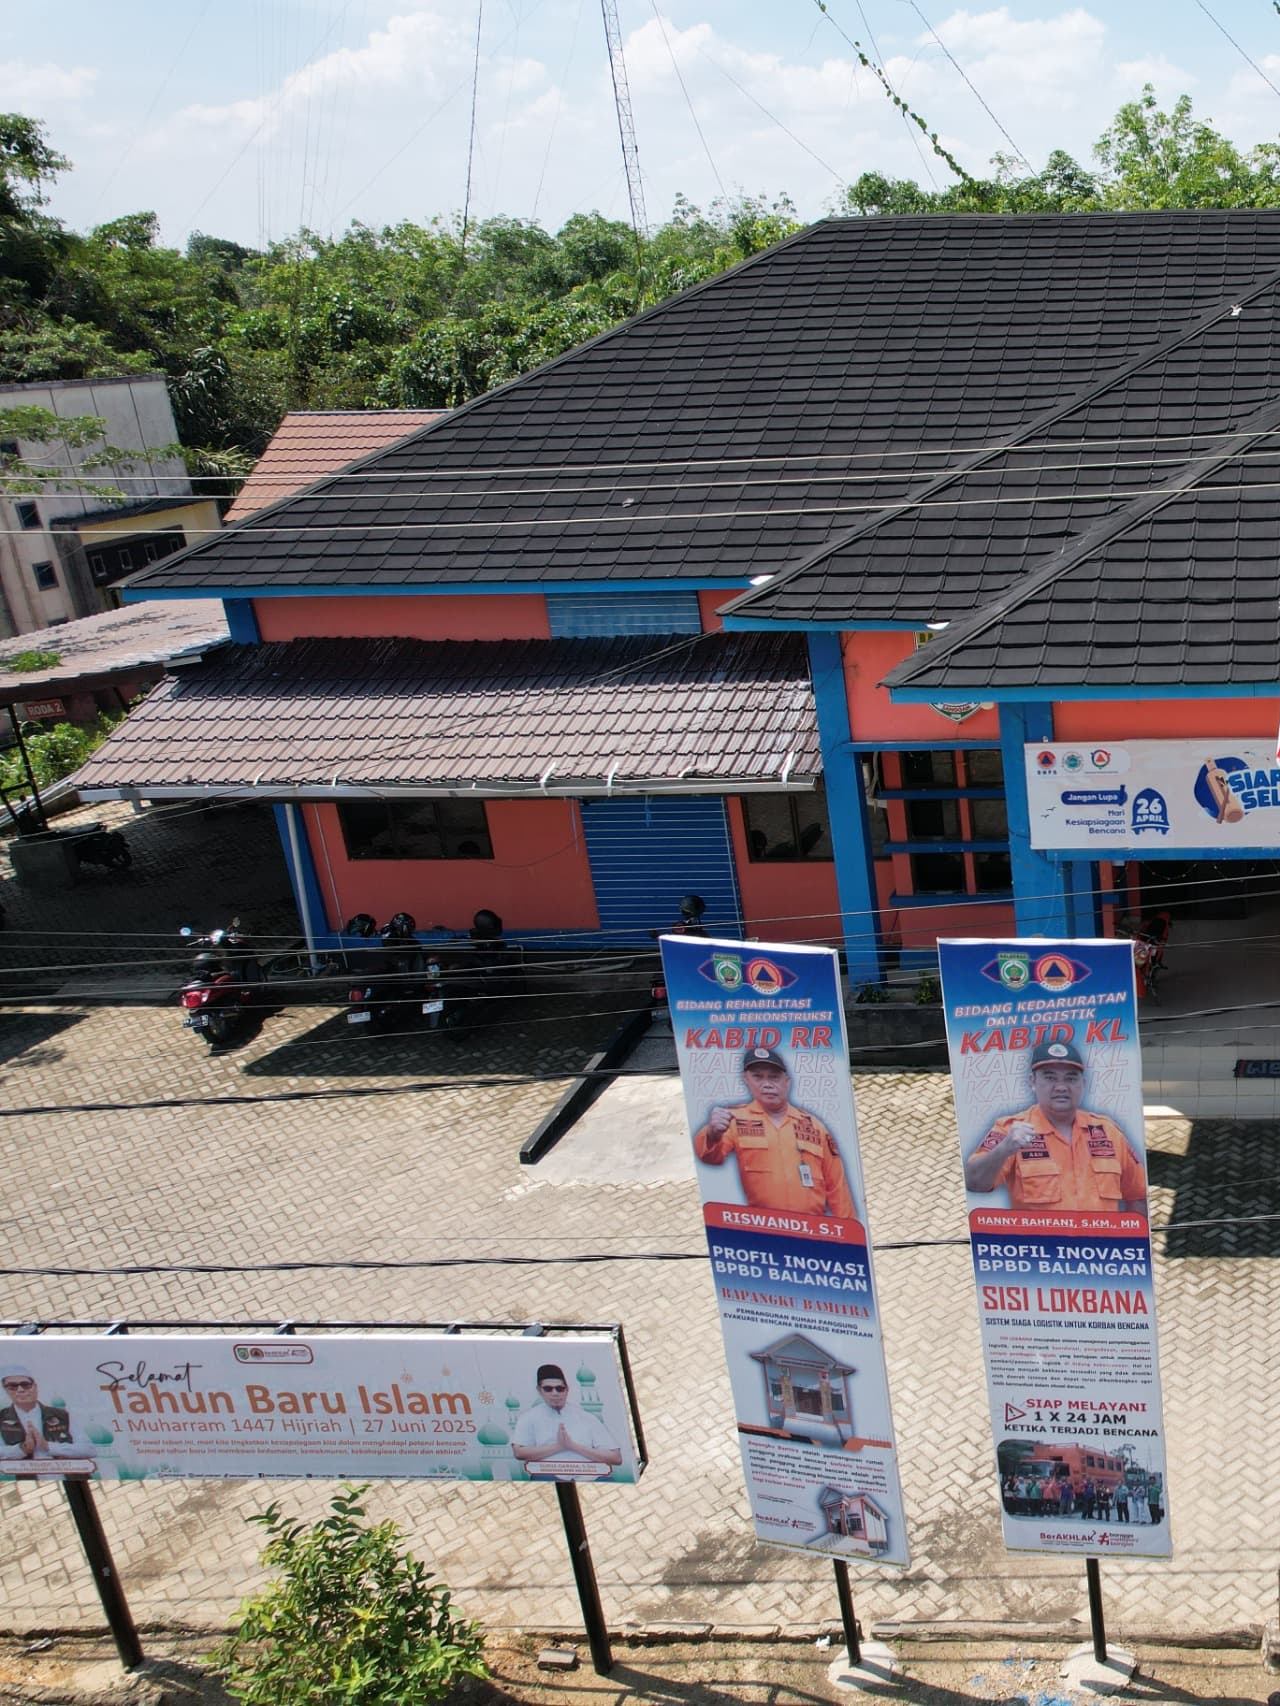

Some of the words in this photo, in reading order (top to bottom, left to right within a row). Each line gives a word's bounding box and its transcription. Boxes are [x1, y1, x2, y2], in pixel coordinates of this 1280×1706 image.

[1068, 794, 1097, 803] Jangan
[1099, 794, 1118, 802] Lupa
[1136, 798, 1163, 814] 26
[1066, 819, 1126, 827] Kesiapsiagaan
[1136, 815, 1164, 823] APRIL
[676, 1000, 722, 1010] BIDANG
[725, 998, 812, 1009] REHABILITASI
[954, 1002, 1013, 1017] BIDANG
[1017, 992, 1127, 1011] KEDARURATAN
[709, 1012, 735, 1023] DAN
[738, 1011, 833, 1022] REKONSTRUKSI
[986, 1016, 1018, 1027] DAN
[1022, 1008, 1097, 1023] LOGISTIK
[685, 1027, 782, 1050] KABID
[791, 1026, 833, 1049] RR
[960, 1024, 1074, 1054] KABID
[1085, 1018, 1128, 1044] KL
[722, 1211, 814, 1235] RISWANDI,
[819, 1223, 844, 1237] S.T
[977, 1216, 1018, 1225] HANNY
[1021, 1218, 1078, 1228] RAHFANI,
[1121, 1219, 1140, 1228] MM
[977, 1244, 1051, 1258] PROFIL
[1057, 1246, 1146, 1261] INOVASI
[712, 1246, 779, 1266] PROFIL
[784, 1255, 866, 1277] INOVASI
[978, 1259, 1032, 1273] BPBD
[1039, 1260, 1147, 1276] BALANGAN
[715, 1261, 762, 1278] BPBD
[768, 1267, 868, 1292] BALANGAN
[982, 1286, 1029, 1311] SISI
[1037, 1287, 1148, 1315] LOKBANA
[723, 1312, 758, 1324] EVAKUASI
[985, 1317, 1010, 1326] SISTEM
[1011, 1318, 1032, 1327] SIAGA
[1033, 1319, 1063, 1328] LOGISTIK
[1064, 1320, 1087, 1329] UNTUK
[1088, 1321, 1116, 1329] KORBAN
[1117, 1322, 1149, 1330] BENCANA
[96, 1361, 202, 1392] Selamat
[100, 1383, 235, 1414] Tahun
[245, 1384, 347, 1414] Baru
[357, 1383, 473, 1415] Islam
[1025, 1398, 1063, 1409] SIAP
[1068, 1400, 1147, 1412] MELAYANI
[1034, 1411, 1043, 1421] 1
[1049, 1411, 1061, 1422] X
[1066, 1412, 1087, 1423] 24
[1093, 1413, 1127, 1425] JAM
[113, 1418, 122, 1432] 1
[128, 1418, 226, 1432] Muharram
[231, 1418, 274, 1432] 1447
[282, 1418, 342, 1436] Hijriah
[362, 1419, 384, 1433] 27
[391, 1418, 426, 1433] Juni
[432, 1419, 477, 1433] 2025
[1004, 1424, 1048, 1433] KETIKA
[1051, 1425, 1099, 1436] TERJADI
[1102, 1427, 1158, 1437] BENCANA
[1039, 1530, 1094, 1541] BerAKHLAK
